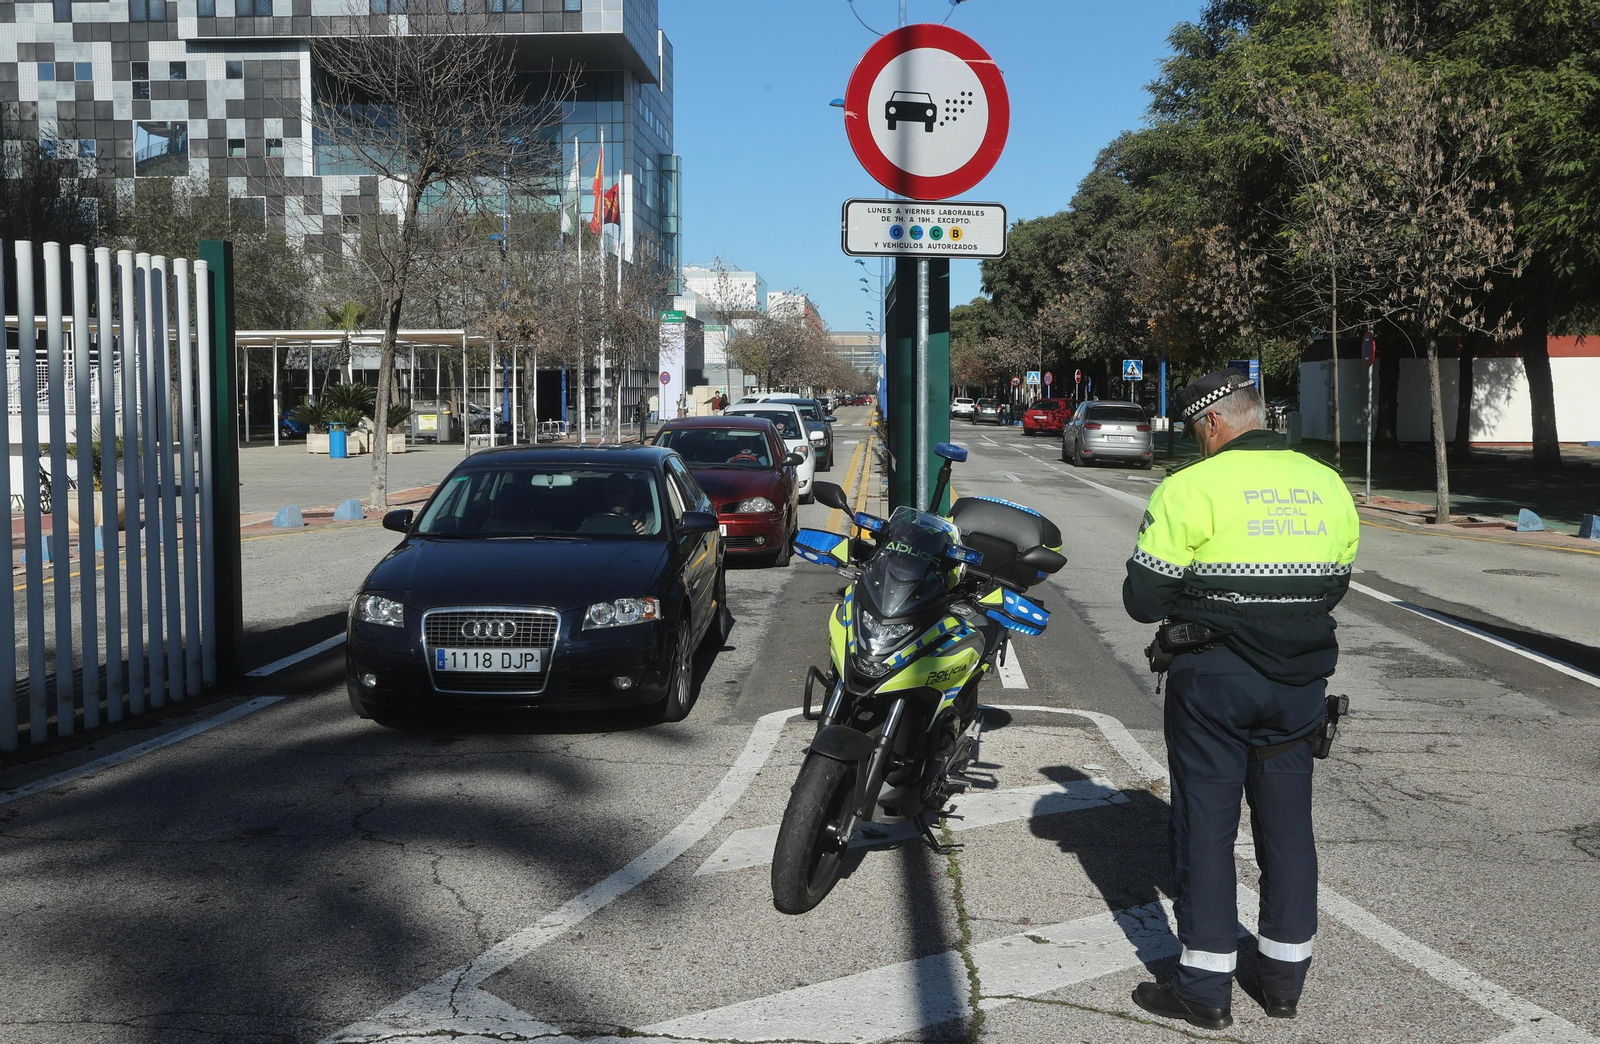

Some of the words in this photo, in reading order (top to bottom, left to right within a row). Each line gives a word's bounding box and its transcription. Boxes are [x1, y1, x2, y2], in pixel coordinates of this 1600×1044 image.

[938, 209, 985, 217] LABORABLES
[932, 228, 940, 237] C
[1243, 488, 1323, 505] POLICIA
[1267, 507, 1307, 516] LOCAL
[1247, 519, 1328, 536] SEVILLA
[451, 652, 493, 669] 1118
[501, 652, 535, 669] DJP
